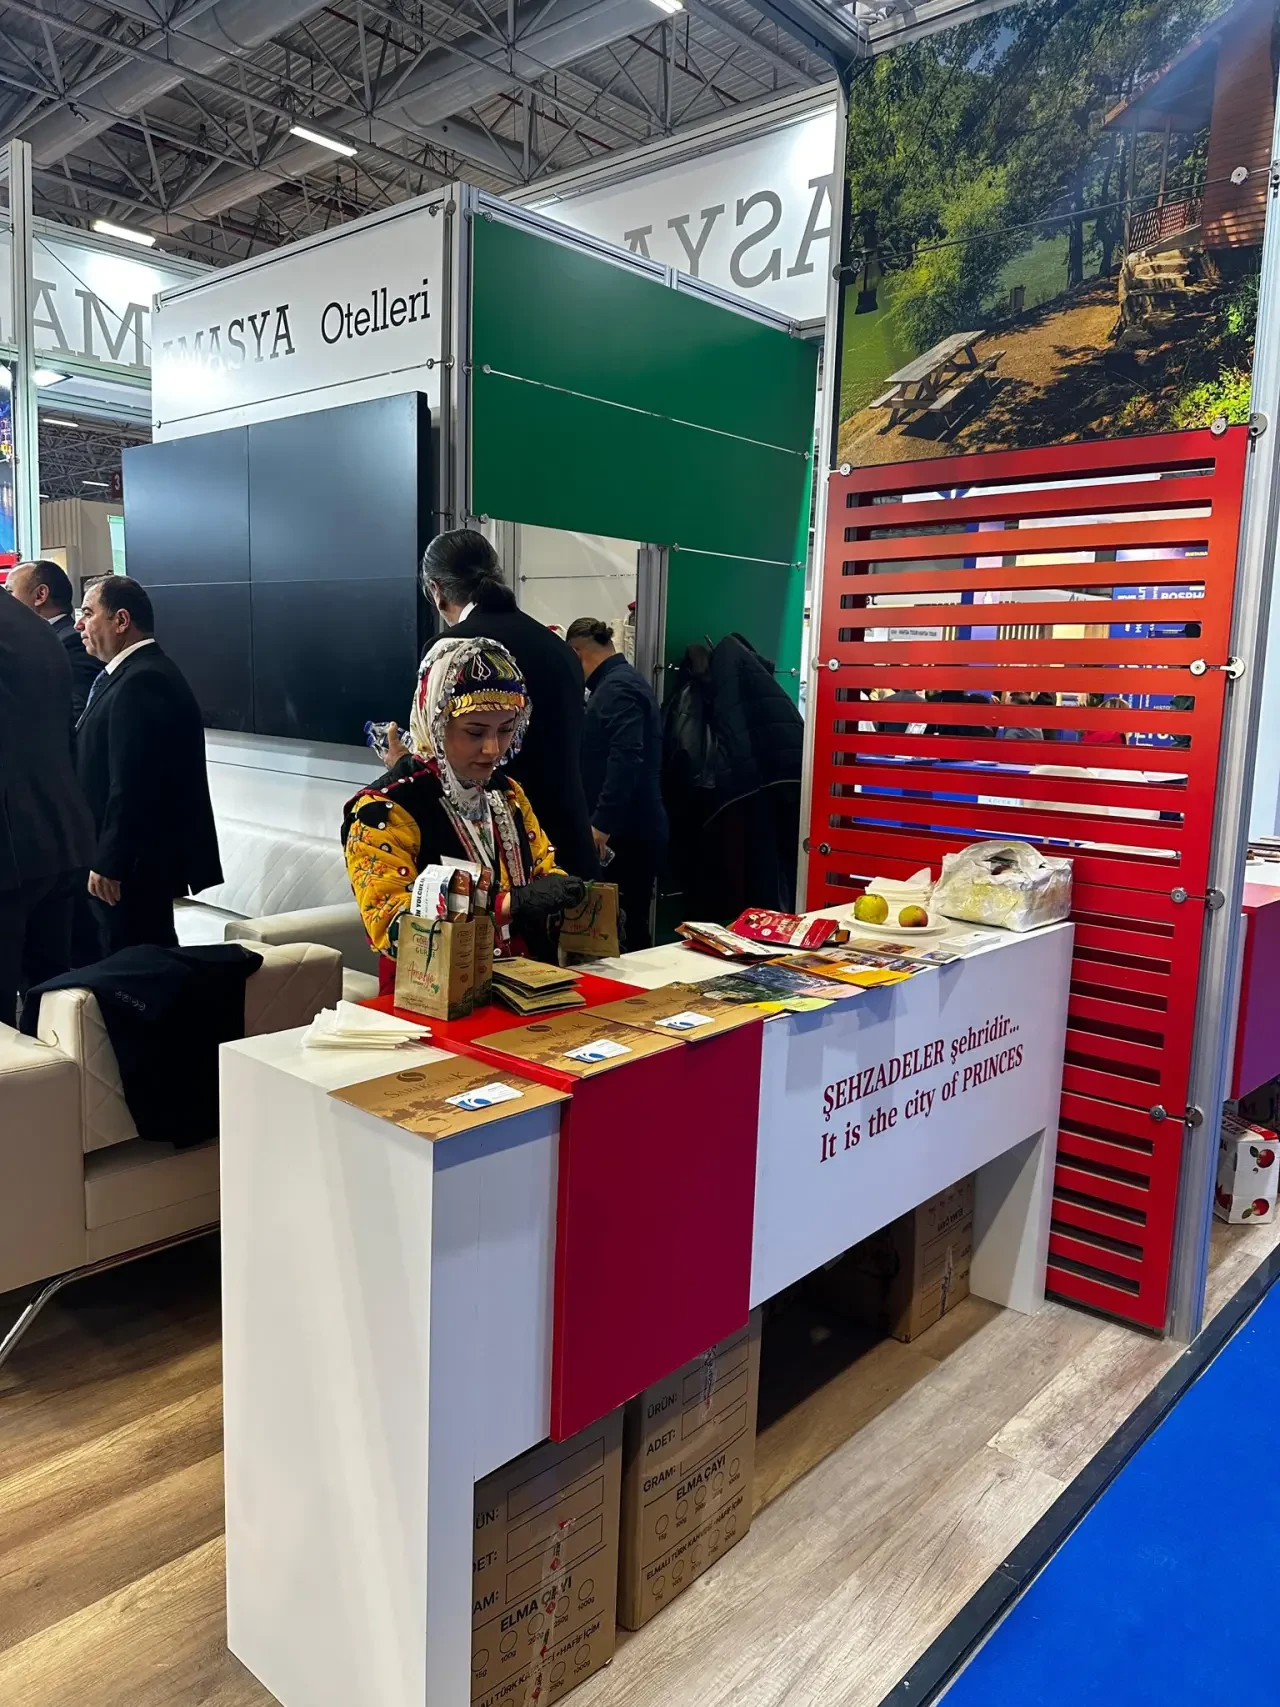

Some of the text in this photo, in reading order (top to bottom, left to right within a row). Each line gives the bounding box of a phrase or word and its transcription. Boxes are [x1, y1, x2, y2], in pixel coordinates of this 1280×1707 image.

[321, 278, 431, 344] Otelleri
[823, 1015, 1020, 1122] ŞEHZADELER şehridir...
[820, 1044, 1024, 1163] It is the city of PRINCES
[648, 1393, 677, 1419] ÜRÜN:
[646, 1429, 676, 1456] ADET:
[643, 1465, 676, 1492] GRAM:
[677, 1474, 702, 1500] ELMA
[704, 1454, 726, 1481] ÇAYI
[473, 1508, 499, 1530] ÜN:
[501, 1600, 539, 1633] ELMA
[501, 1651, 517, 1663] 100g
[578, 1597, 595, 1610] 1000g
[495, 1680, 517, 1700] TÜRK
